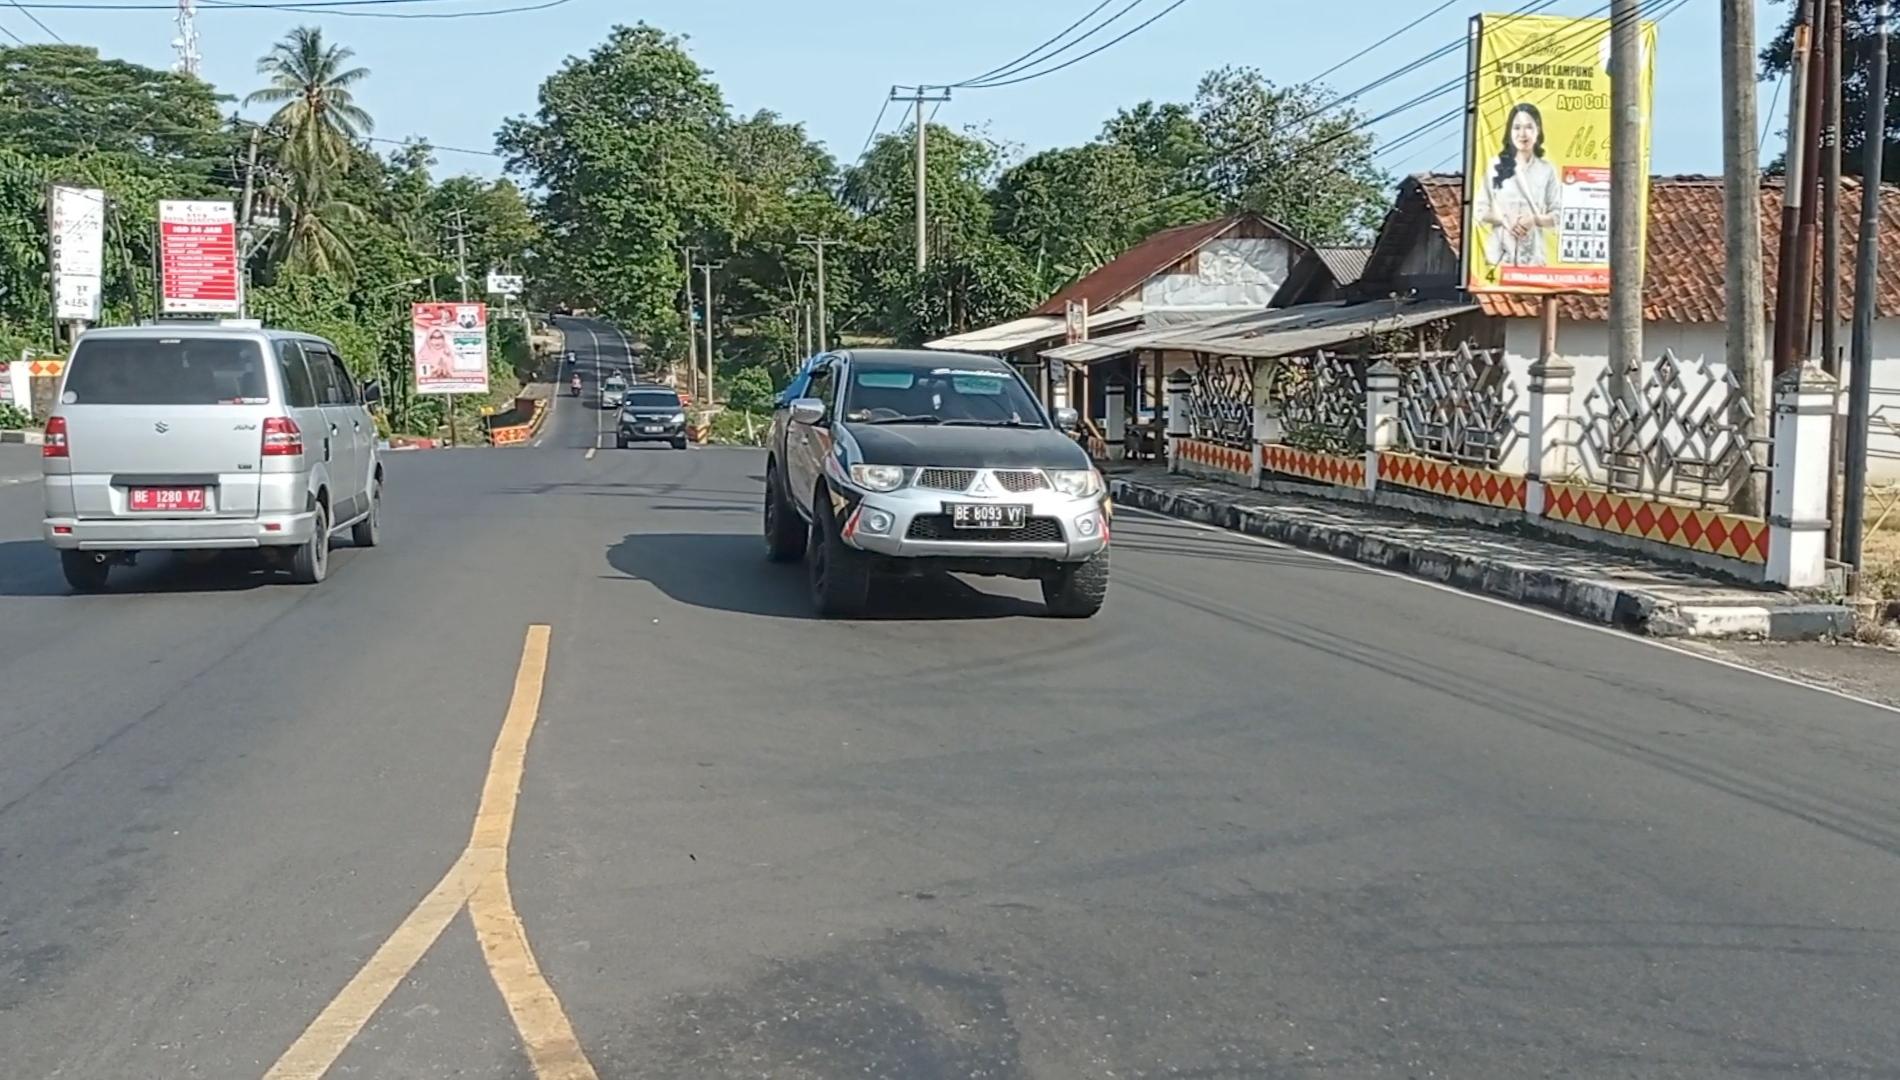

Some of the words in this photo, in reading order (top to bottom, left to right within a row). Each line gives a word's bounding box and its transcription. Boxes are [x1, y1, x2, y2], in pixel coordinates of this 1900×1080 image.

[1552, 65, 1594, 78] LAMPUNG
[1557, 94, 1582, 112] Ayo
[1485, 267, 1496, 283] 4
[134, 490, 149, 503] BE
[156, 490, 183, 503] 1280
[186, 490, 201, 503] VZ
[956, 506, 970, 521] BE
[1007, 507, 1022, 522] VY
